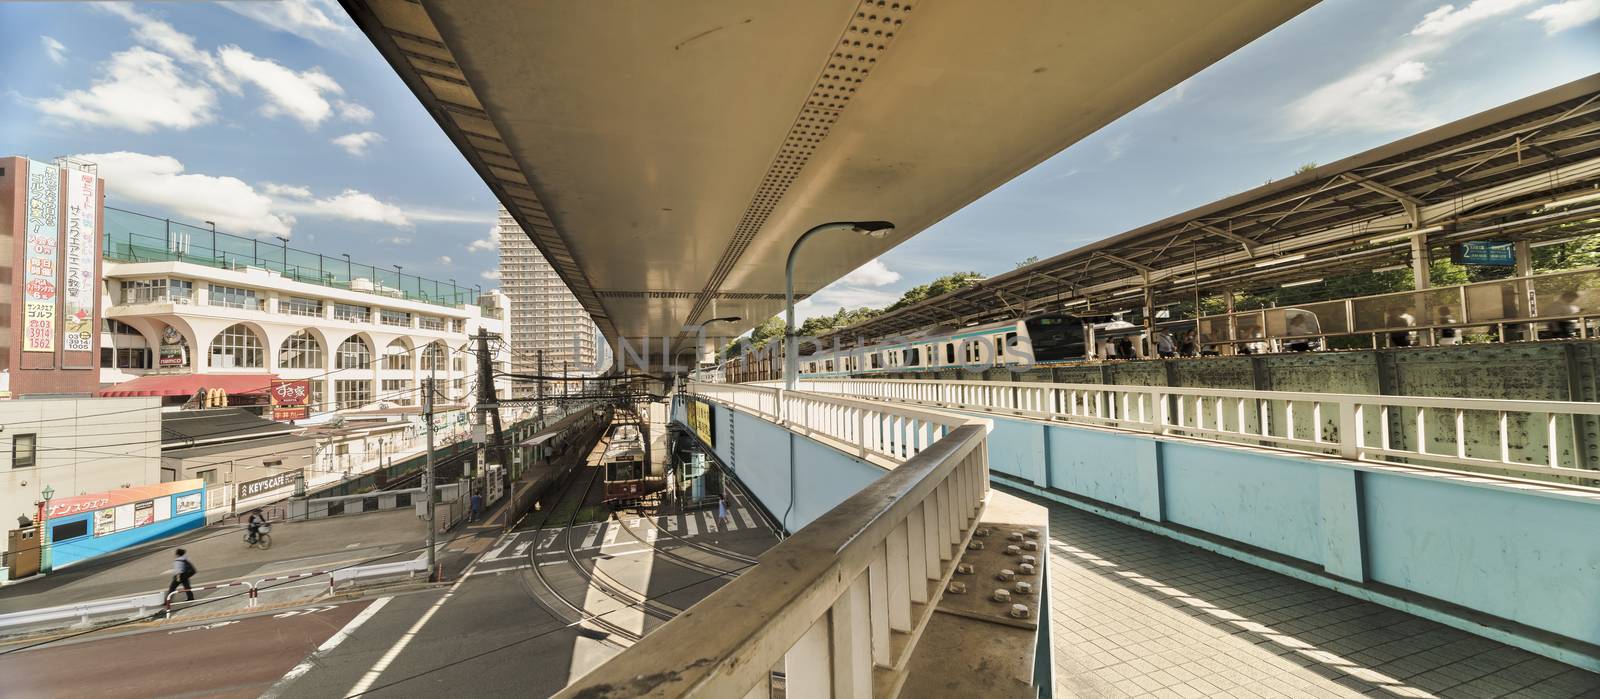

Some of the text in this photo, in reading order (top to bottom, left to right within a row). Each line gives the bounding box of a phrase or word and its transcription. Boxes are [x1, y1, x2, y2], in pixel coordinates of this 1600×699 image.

[1463, 244, 1470, 258] 2
[1507, 246, 1511, 259] 1
[28, 303, 54, 312] サンスクエア
[28, 311, 53, 319] ゴルフ
[30, 327, 50, 338] 3914
[30, 338, 50, 349] 1562
[275, 381, 305, 398] すき家
[248, 480, 268, 494] KEY'S
